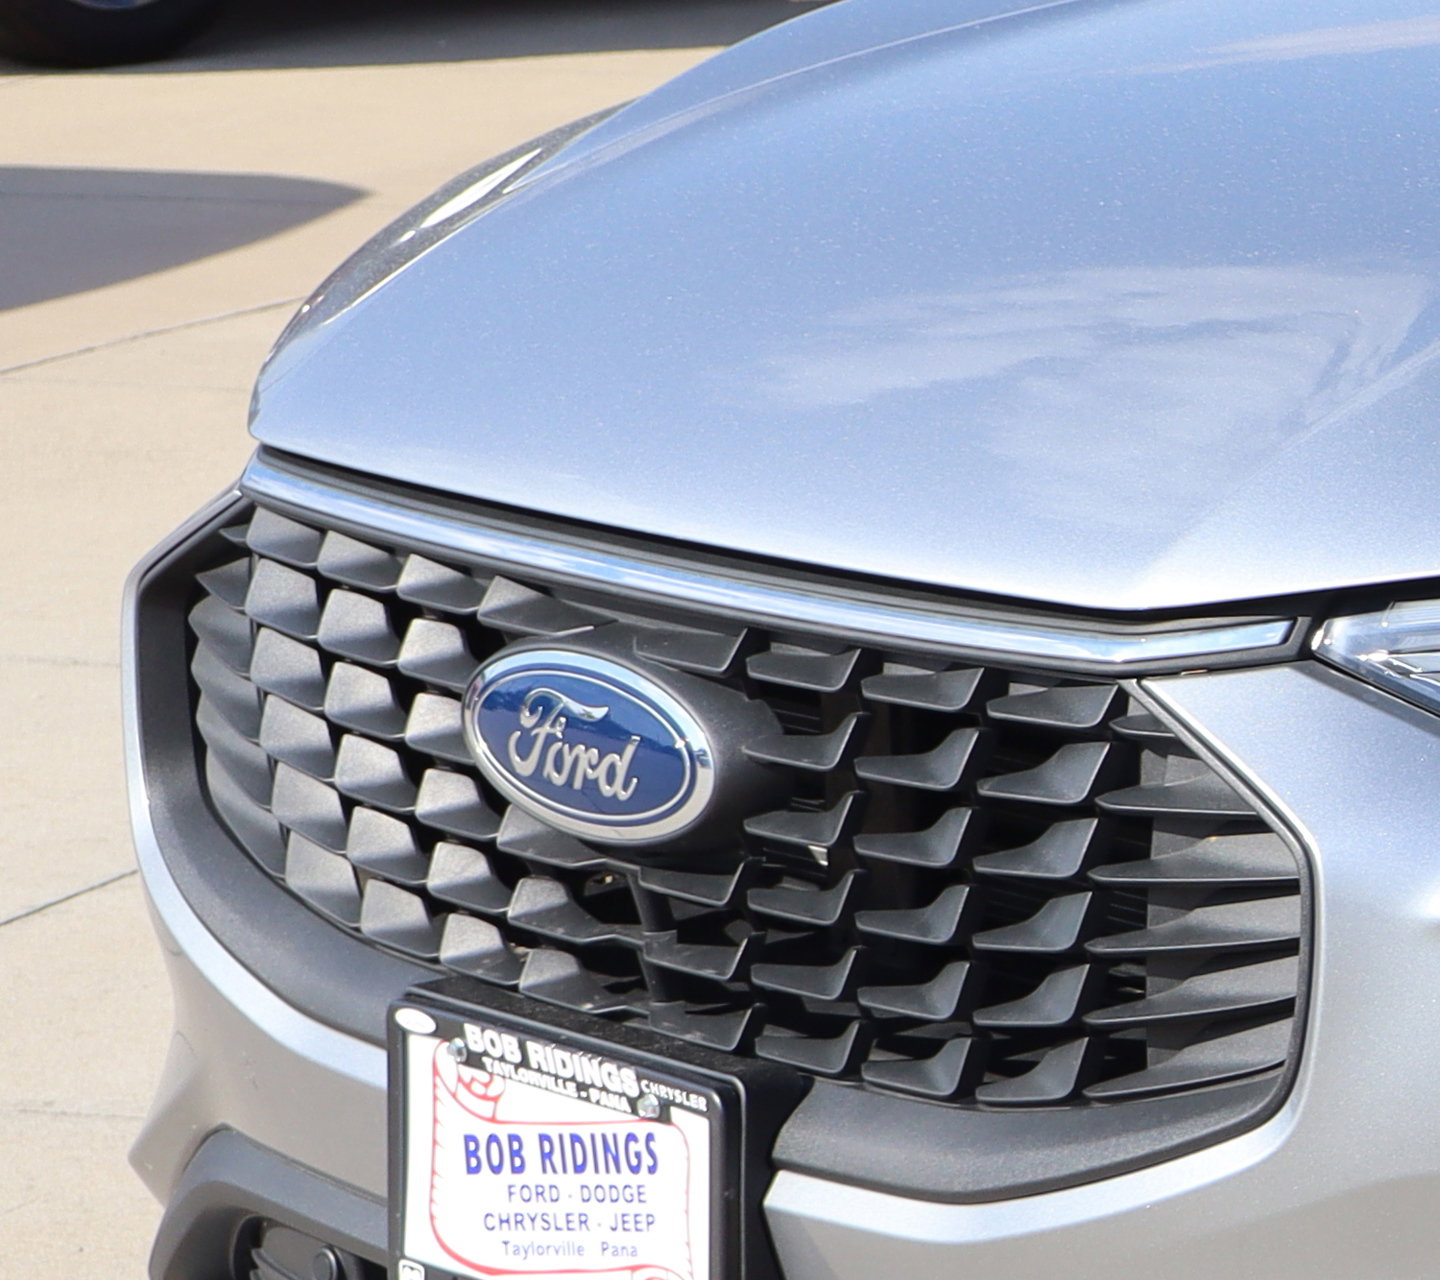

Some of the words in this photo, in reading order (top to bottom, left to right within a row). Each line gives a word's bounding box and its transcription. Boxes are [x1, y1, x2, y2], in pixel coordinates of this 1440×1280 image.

[507, 686, 642, 802] Ford
[463, 1022, 523, 1064] BOB
[526, 1039, 641, 1099] RIDINGS
[481, 1056, 579, 1099] TAYLORVILLE
[588, 1086, 633, 1114] PANA
[640, 1079, 709, 1113] CHRYSLER
[463, 1132, 527, 1176] BOB
[537, 1131, 660, 1176] RIDINGS
[507, 1183, 561, 1204] FORD
[579, 1183, 648, 1204] DODGE
[482, 1211, 591, 1232] CHRYSLER
[608, 1212, 657, 1233] JEEP
[501, 1239, 586, 1261] Taylorville
[600, 1240, 639, 1258] Pana
